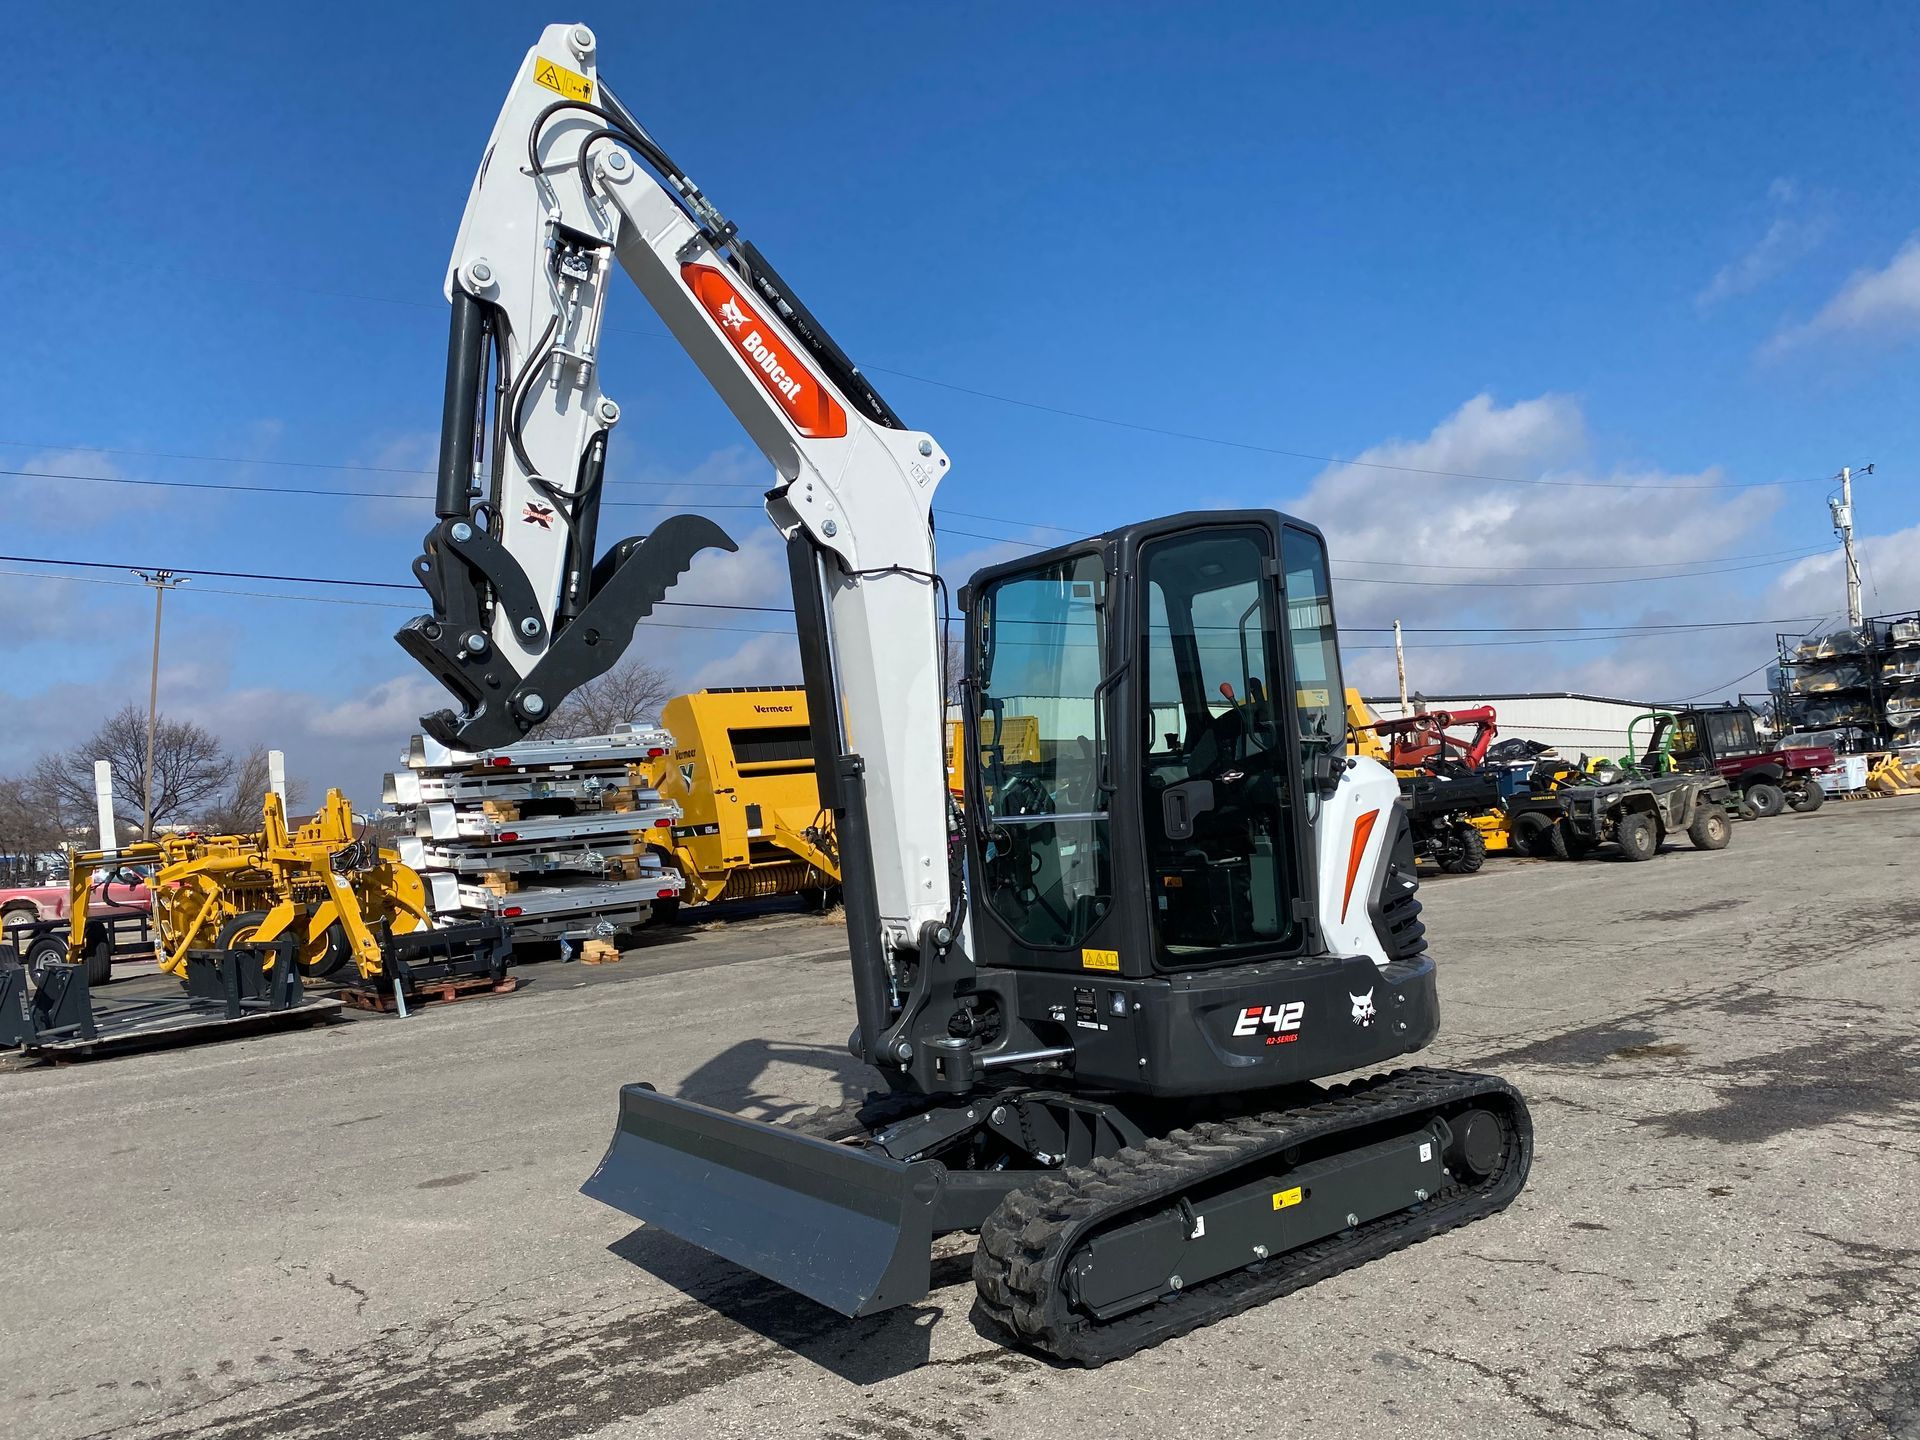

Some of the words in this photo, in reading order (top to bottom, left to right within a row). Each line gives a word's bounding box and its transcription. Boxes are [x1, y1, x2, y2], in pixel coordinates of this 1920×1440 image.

[742, 330, 802, 402] Bobcat
[753, 704, 793, 713] Vermeer
[675, 749, 696, 760] Vermeer
[1232, 1001, 1305, 1036] E42
[1266, 1034, 1298, 1045] R2-SERIES
